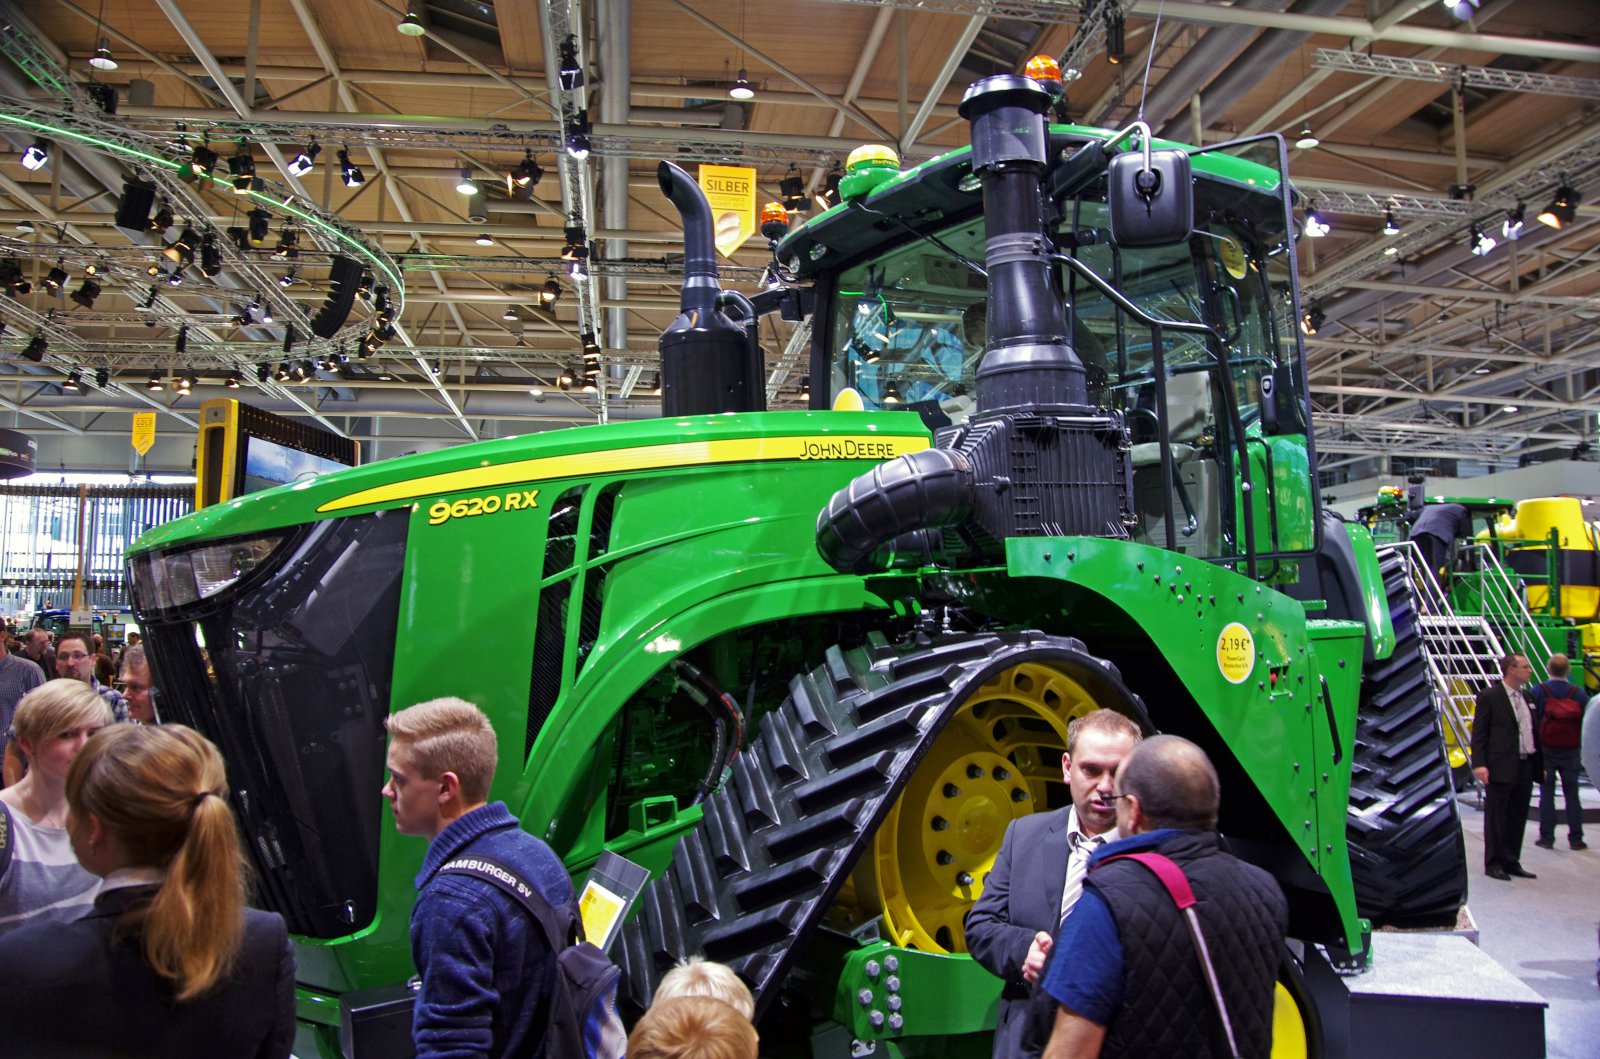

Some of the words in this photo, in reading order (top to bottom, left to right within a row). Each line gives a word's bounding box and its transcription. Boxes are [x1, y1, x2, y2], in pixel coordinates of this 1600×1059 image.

[706, 179, 749, 193] SILBER
[429, 495, 502, 525] 9620
[504, 489, 540, 511] RX
[517, 883, 532, 898] SV
